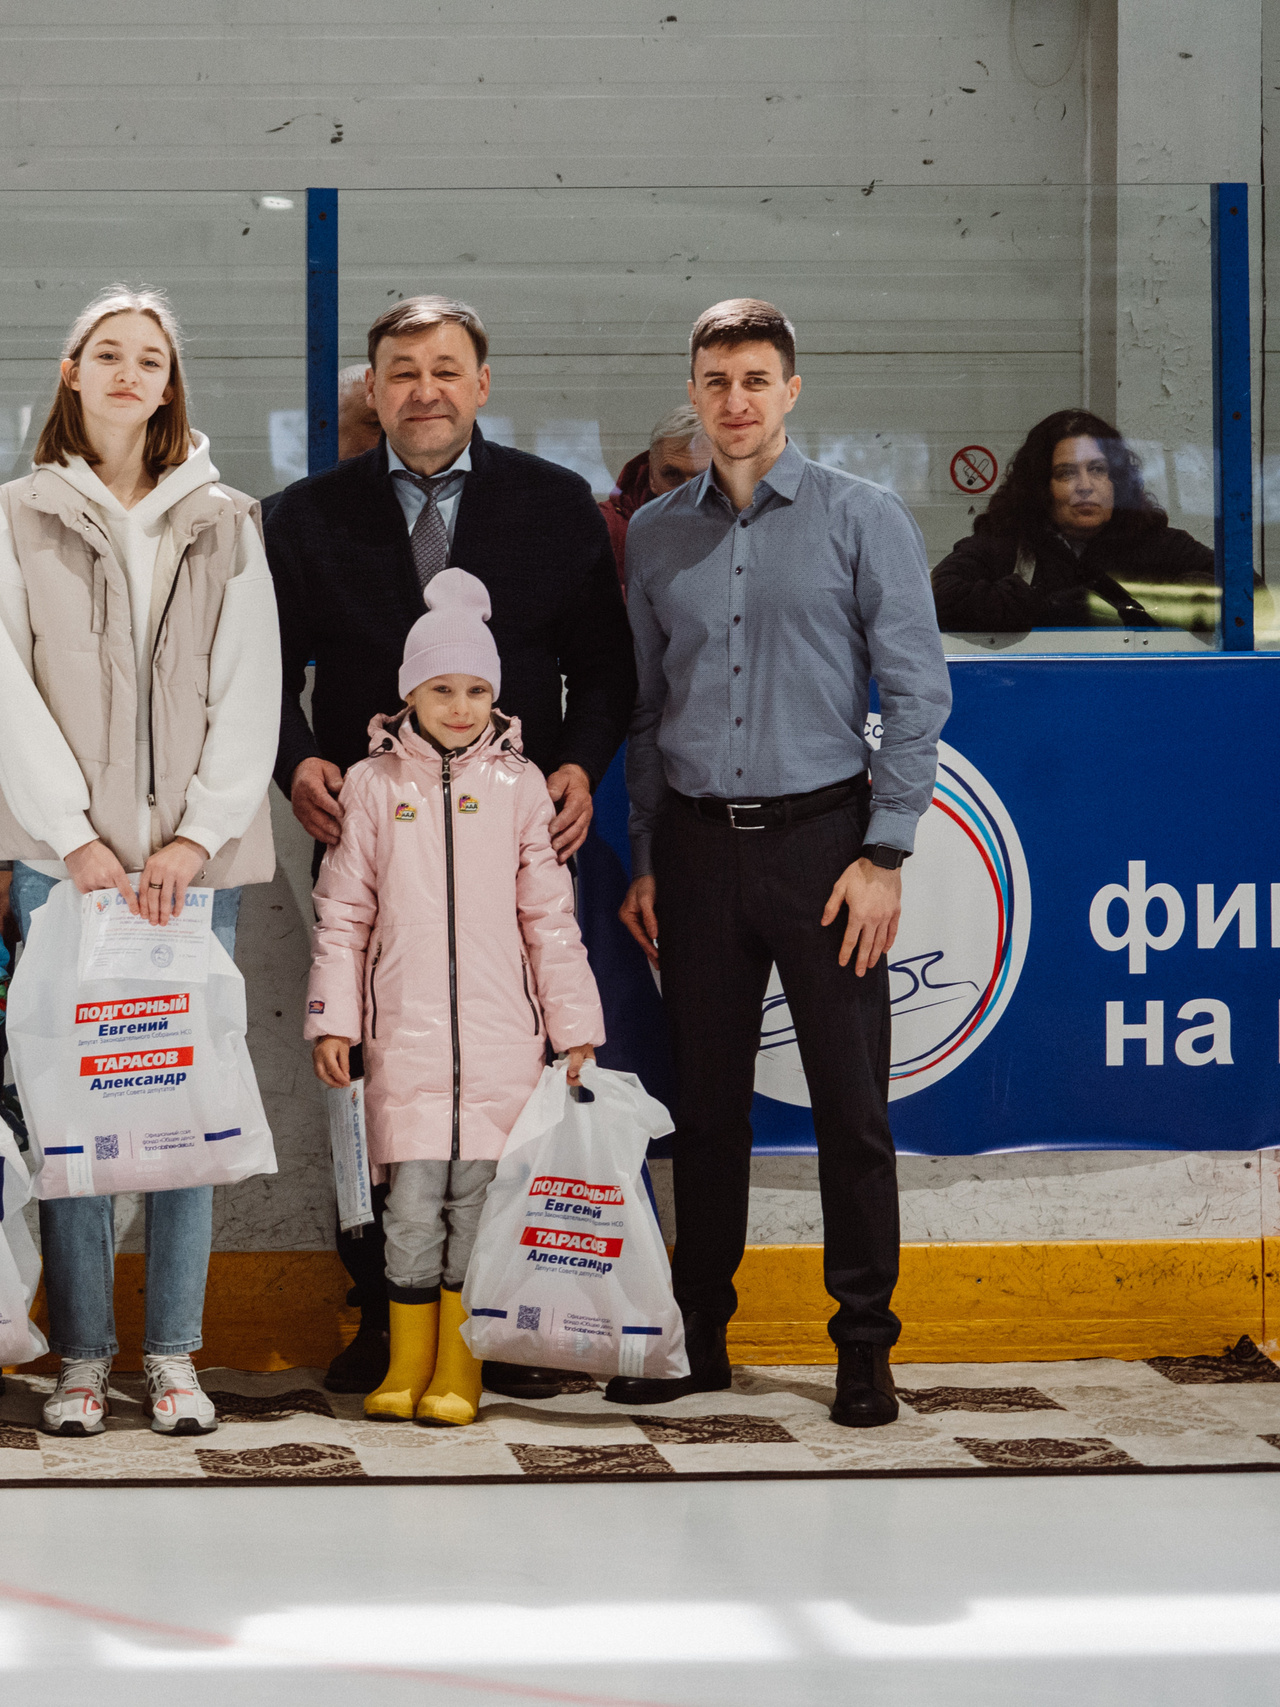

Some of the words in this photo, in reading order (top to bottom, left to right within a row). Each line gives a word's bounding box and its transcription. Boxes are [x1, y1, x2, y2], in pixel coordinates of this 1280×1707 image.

[1089, 860, 1280, 974] фи
[79, 995, 187, 1020] ПОДГОРНЫЙ
[99, 1017, 168, 1036] Евгений
[1106, 998, 1234, 1066] на
[94, 1051, 179, 1072] ТАРАСОВ
[90, 1072, 187, 1091] Александр
[103, 1091, 125, 1099] Депутат
[126, 1088, 146, 1096] Совета
